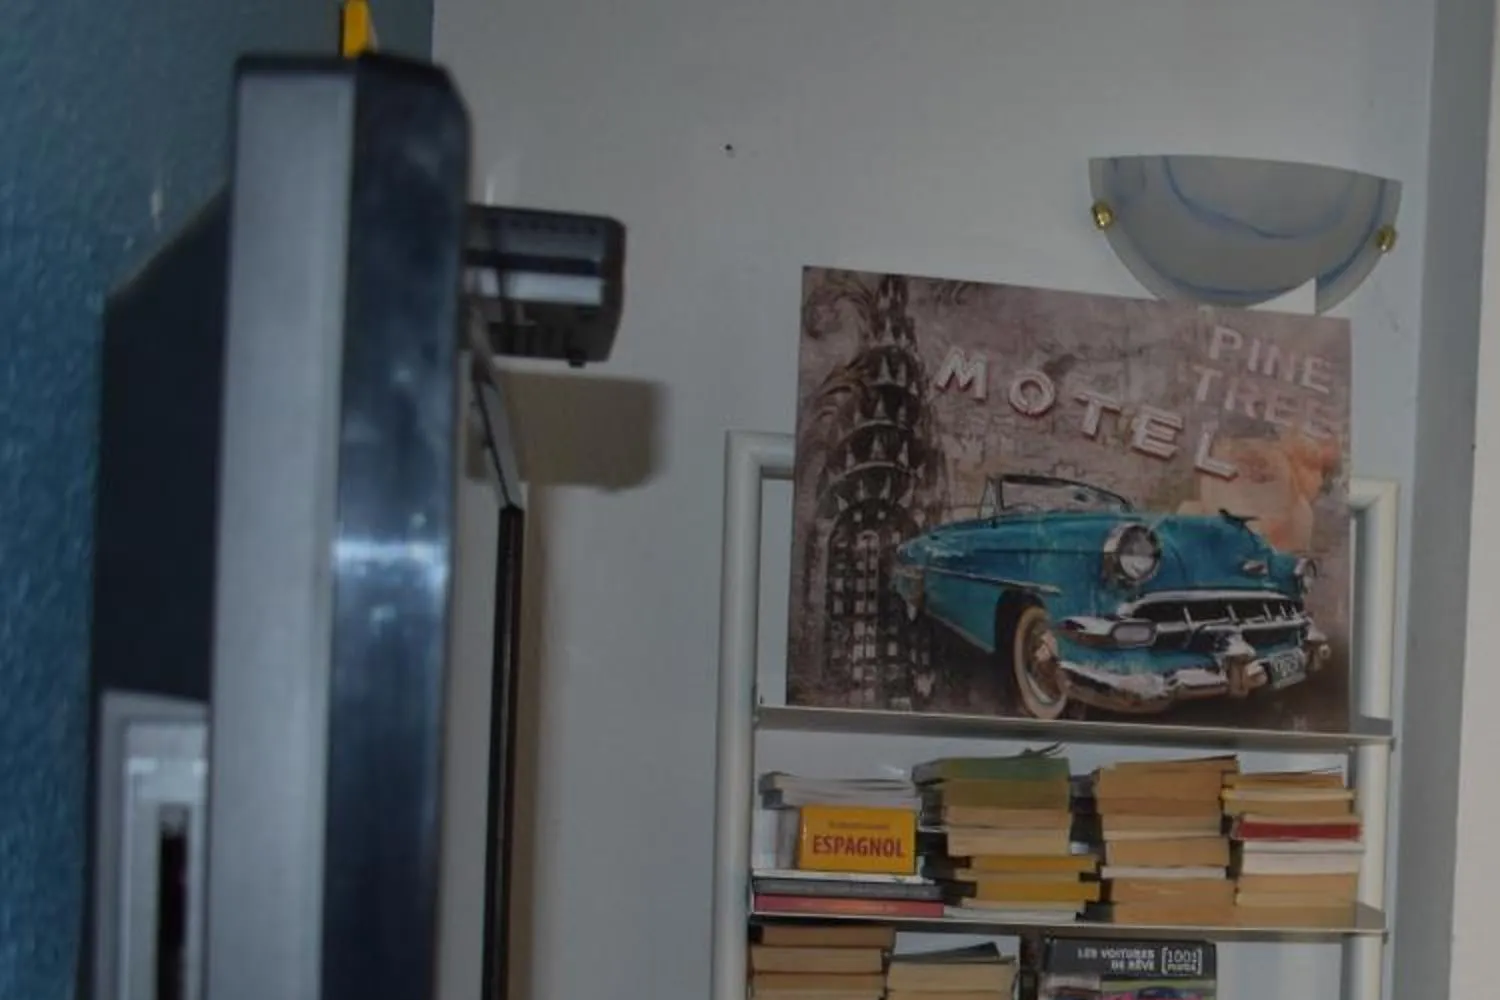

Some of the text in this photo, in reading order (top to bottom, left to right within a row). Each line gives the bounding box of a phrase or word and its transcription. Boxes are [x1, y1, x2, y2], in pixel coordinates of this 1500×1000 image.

[1208, 324, 1331, 395] PINE
[934, 346, 1239, 484] MOTEL
[812, 834, 905, 859] ESPAGNOL
